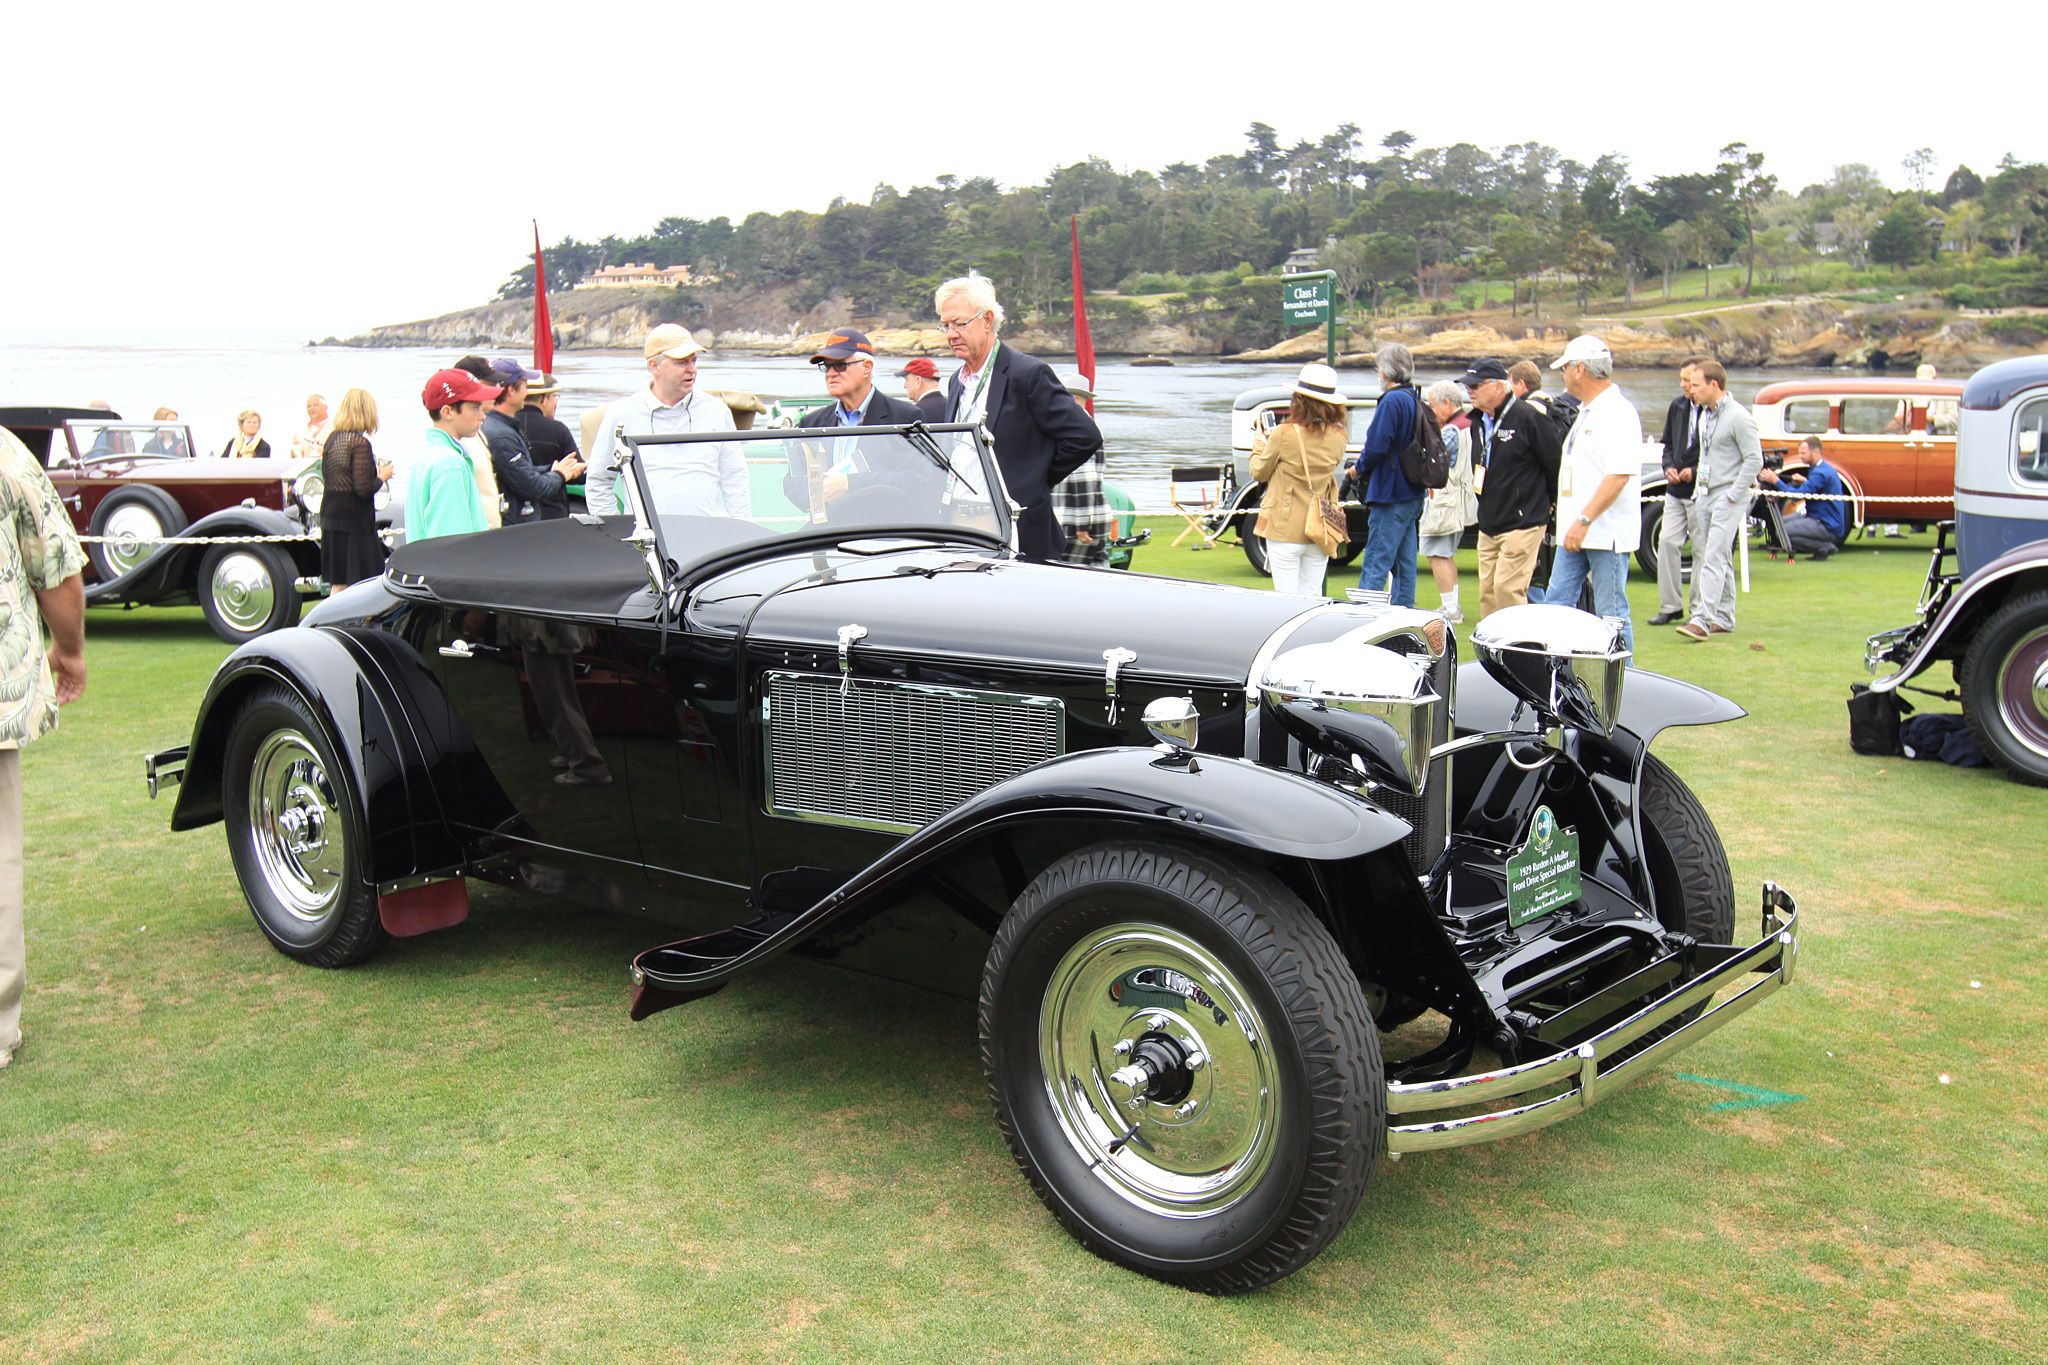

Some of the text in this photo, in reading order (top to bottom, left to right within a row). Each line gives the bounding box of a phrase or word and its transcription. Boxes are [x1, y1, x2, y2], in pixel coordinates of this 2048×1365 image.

[1294, 286, 1318, 299] Class F
[1513, 860, 1576, 892] Front Drive Special Roadster
[1520, 864, 1532, 877] 1929
[1532, 860, 1549, 872] Ruxton
[1549, 856, 1554, 865] A
[1554, 850, 1569, 863] Muller
